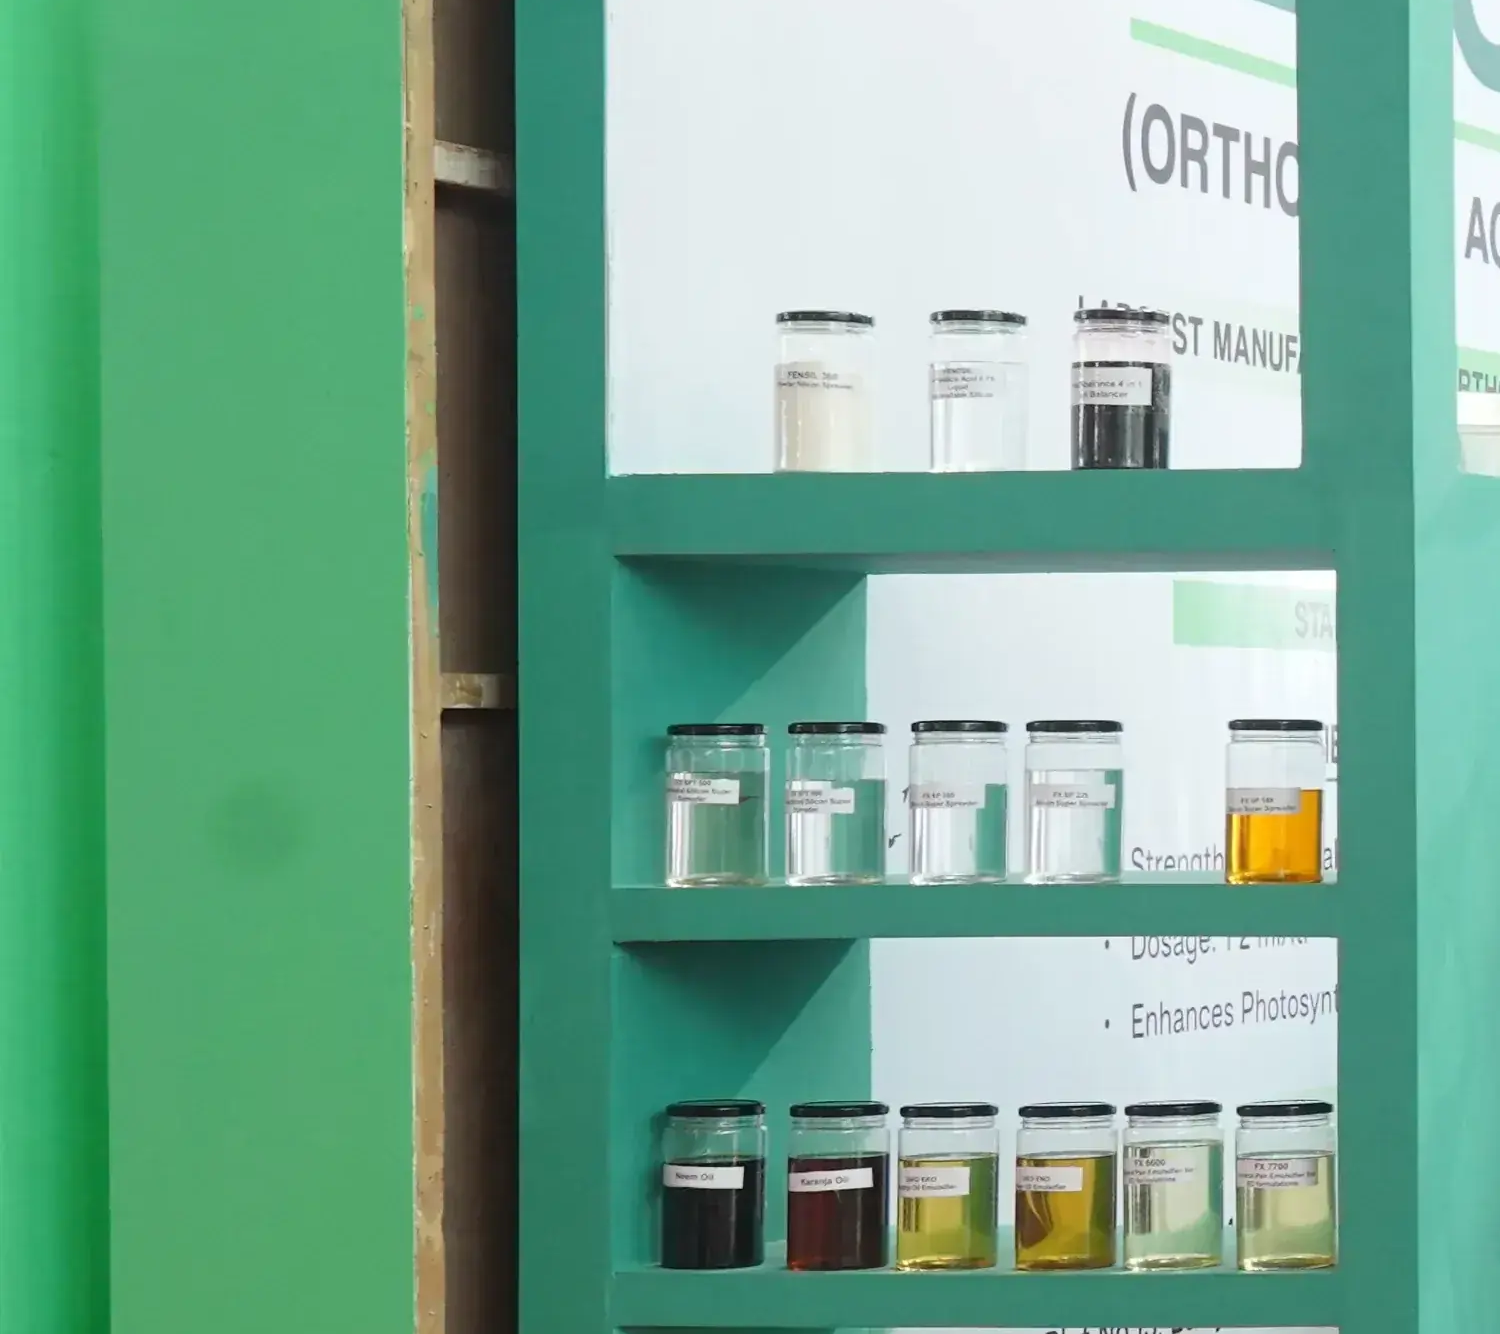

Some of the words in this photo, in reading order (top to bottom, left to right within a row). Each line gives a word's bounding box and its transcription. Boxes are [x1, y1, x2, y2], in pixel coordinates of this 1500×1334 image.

[1132, 1001, 1234, 1038] Enhances
[675, 1172, 697, 1181] Neem
[701, 1172, 714, 1181] Oil
[801, 1176, 832, 1187] Karanja
[835, 1175, 849, 1184] Oil
